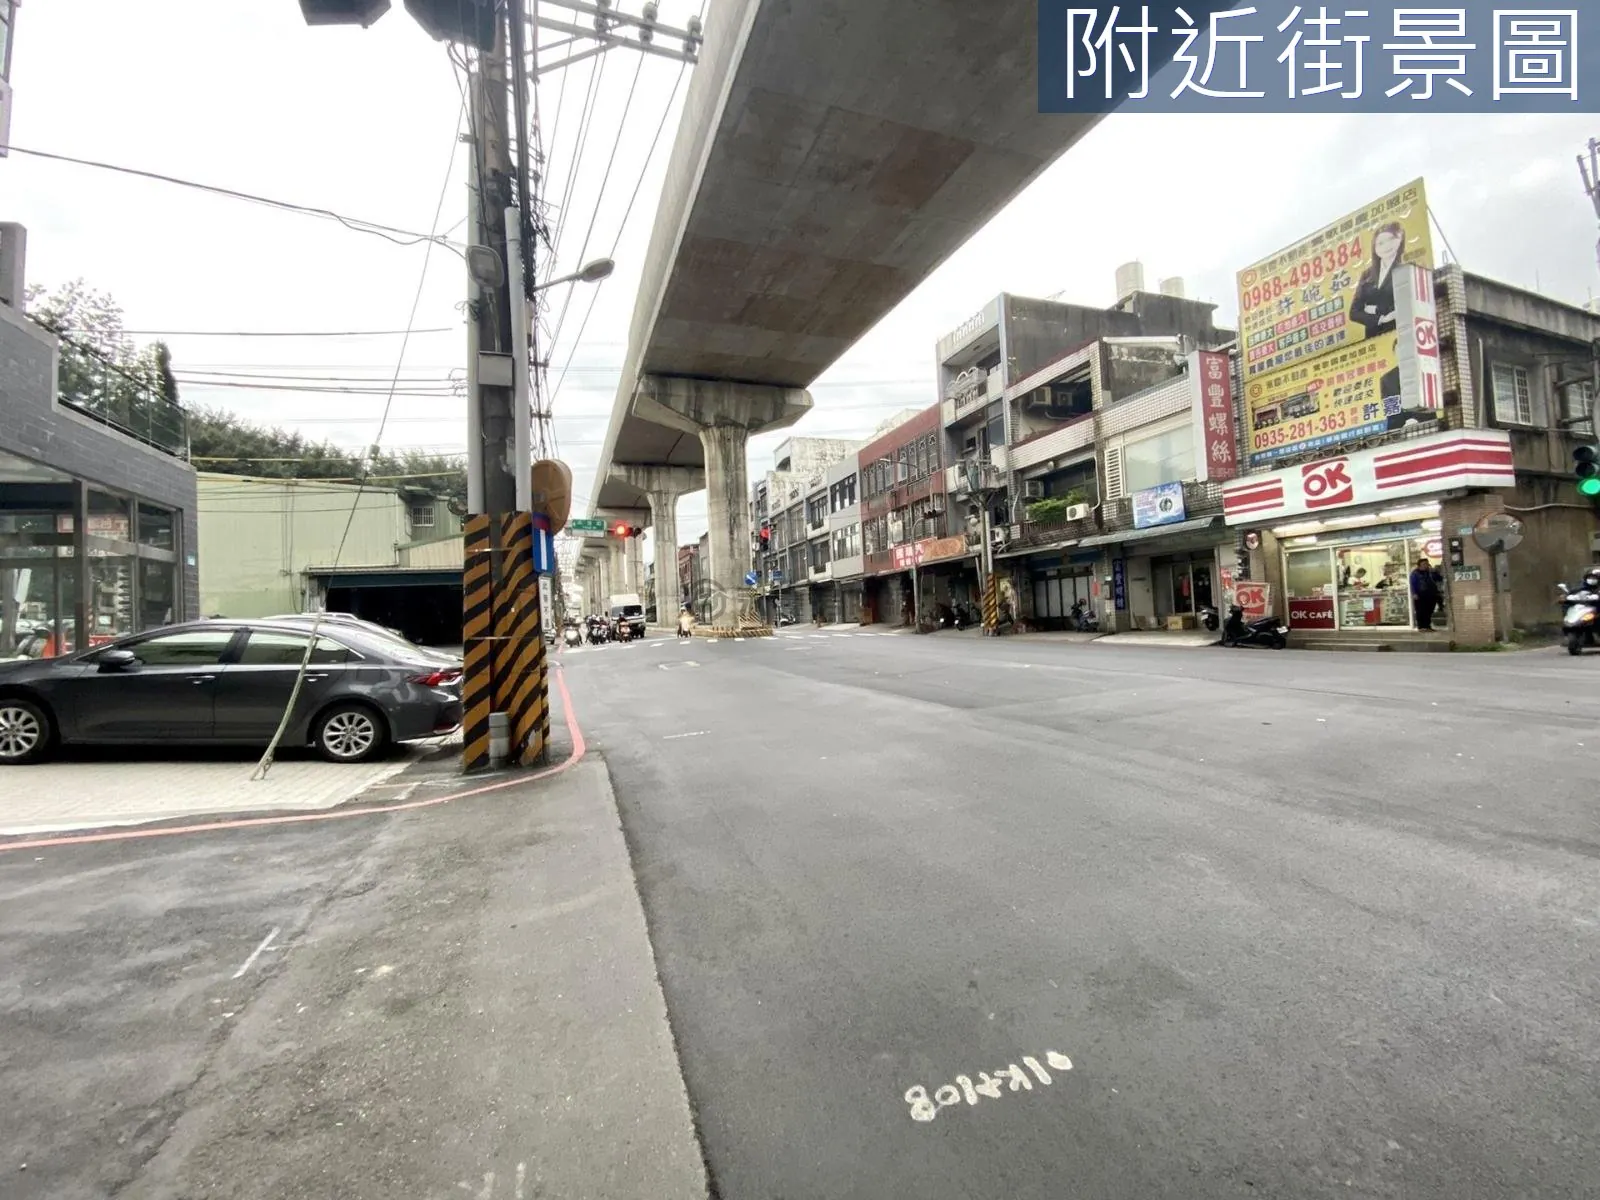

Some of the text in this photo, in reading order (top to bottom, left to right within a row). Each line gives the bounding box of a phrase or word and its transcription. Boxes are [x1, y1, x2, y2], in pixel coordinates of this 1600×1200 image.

[1243, 236, 1363, 311] 0988-498384
[1416, 324, 1437, 347] OK
[1205, 356, 1232, 463] 富豐螺絲
[1254, 411, 1347, 450] 0935-281-363
[1303, 462, 1352, 497] OK
[1236, 588, 1265, 606] OK
[1291, 610, 1308, 620] OK
